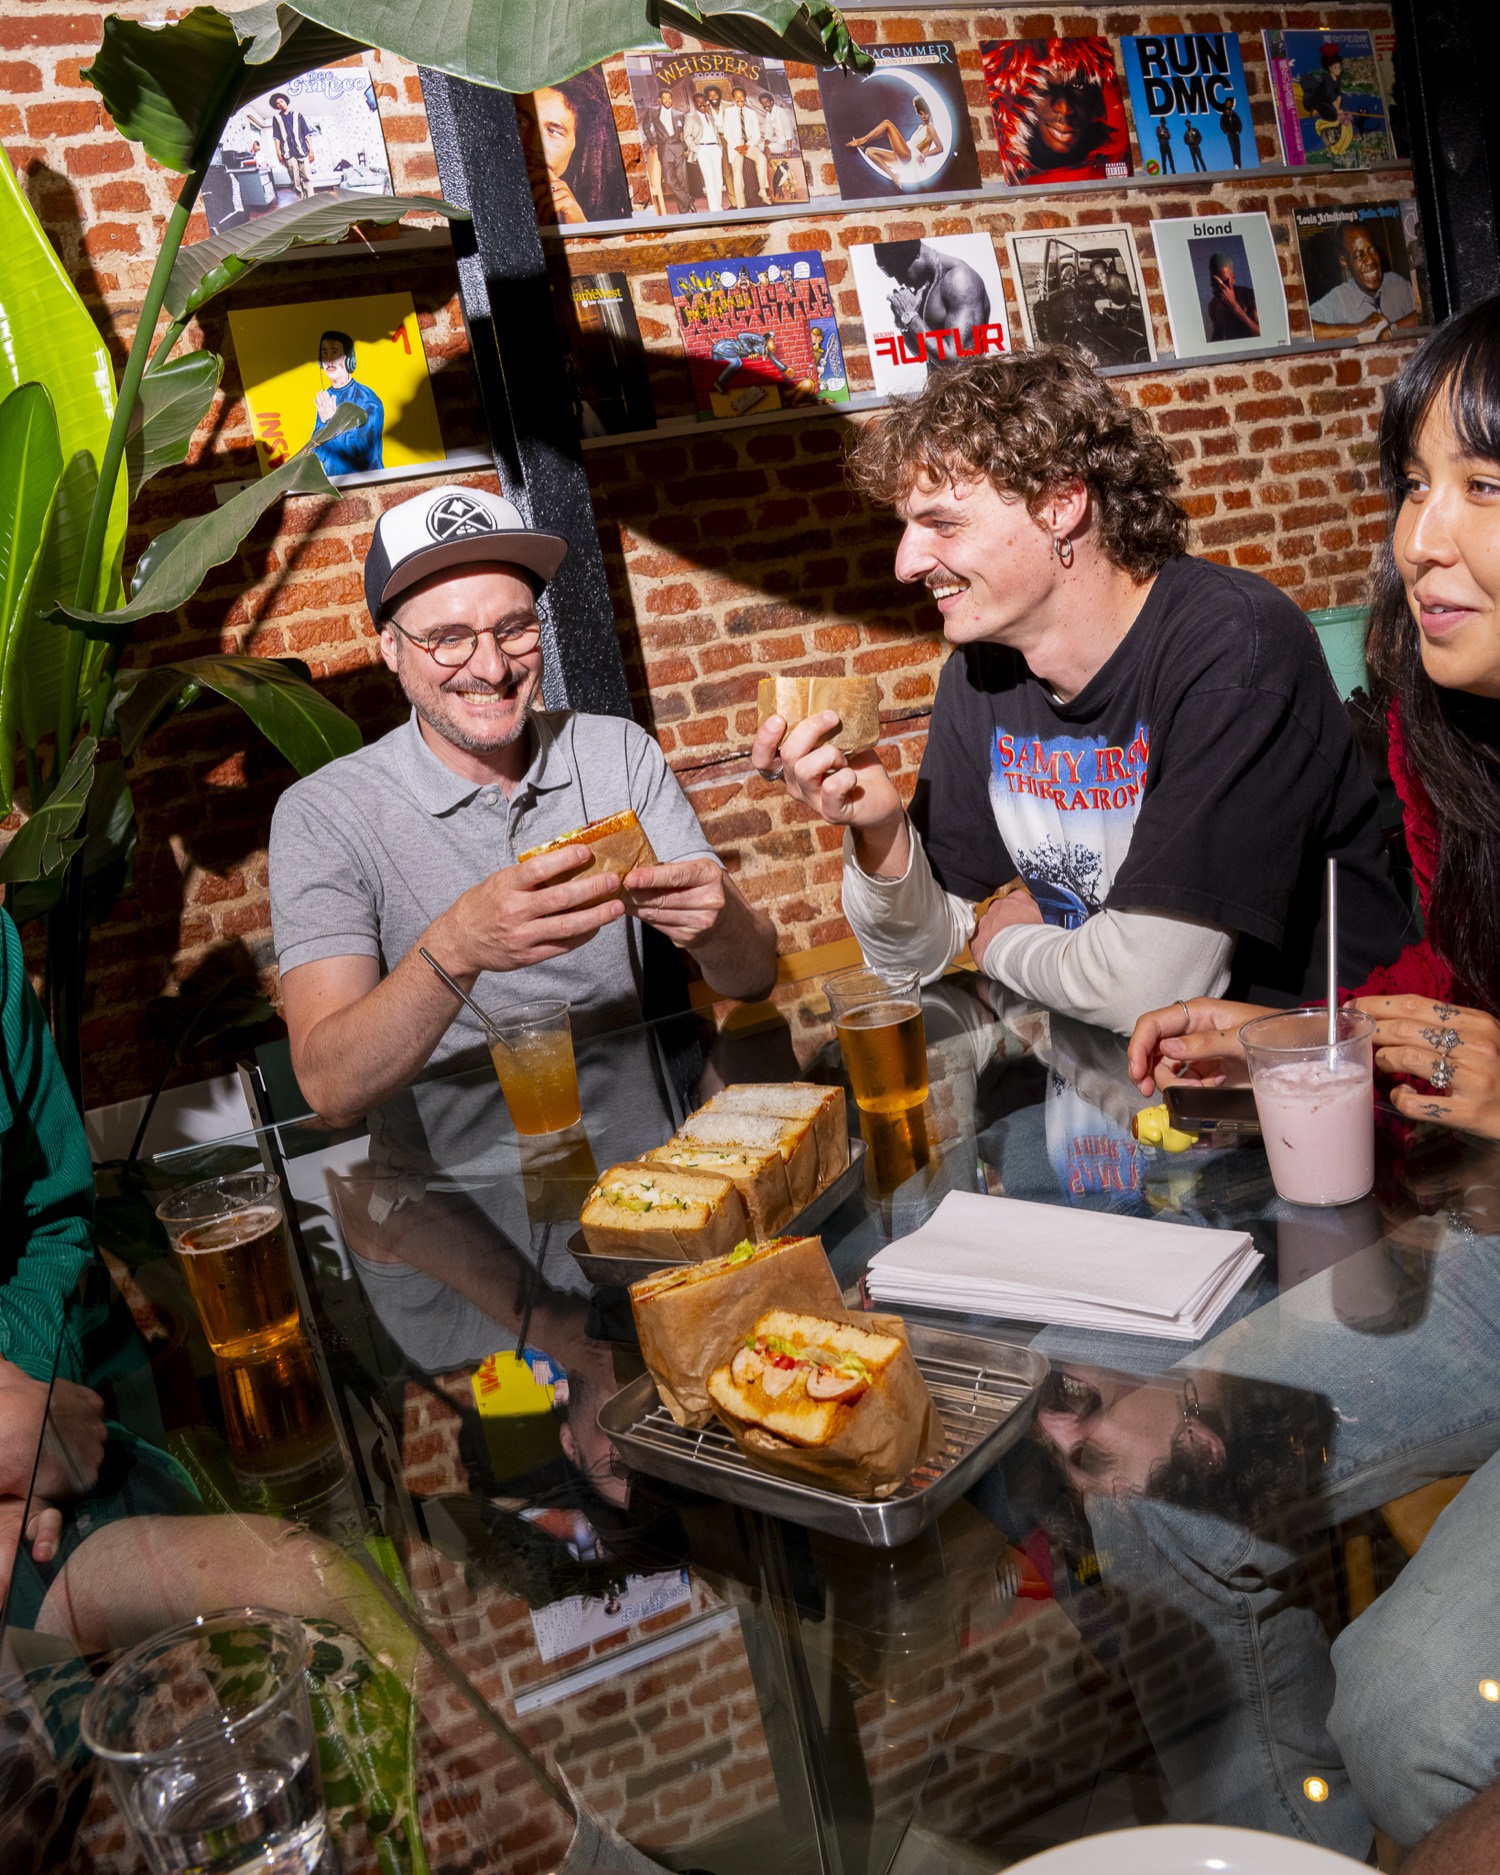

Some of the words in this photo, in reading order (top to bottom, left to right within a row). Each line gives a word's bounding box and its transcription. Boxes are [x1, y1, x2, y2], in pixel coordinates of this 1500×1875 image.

[656, 54, 761, 85] WHISPERS
[905, 56, 915, 64] OF
[918, 55, 936, 63] LOVE
[1136, 35, 1231, 79] RUN
[704, 71, 725, 79] GOOD
[1143, 75, 1237, 117] DMC
[1193, 221, 1232, 236] blond
[1296, 214, 1317, 226] Louis
[874, 323, 1006, 367] FUTUR
[997, 734, 1085, 785] SAMY
